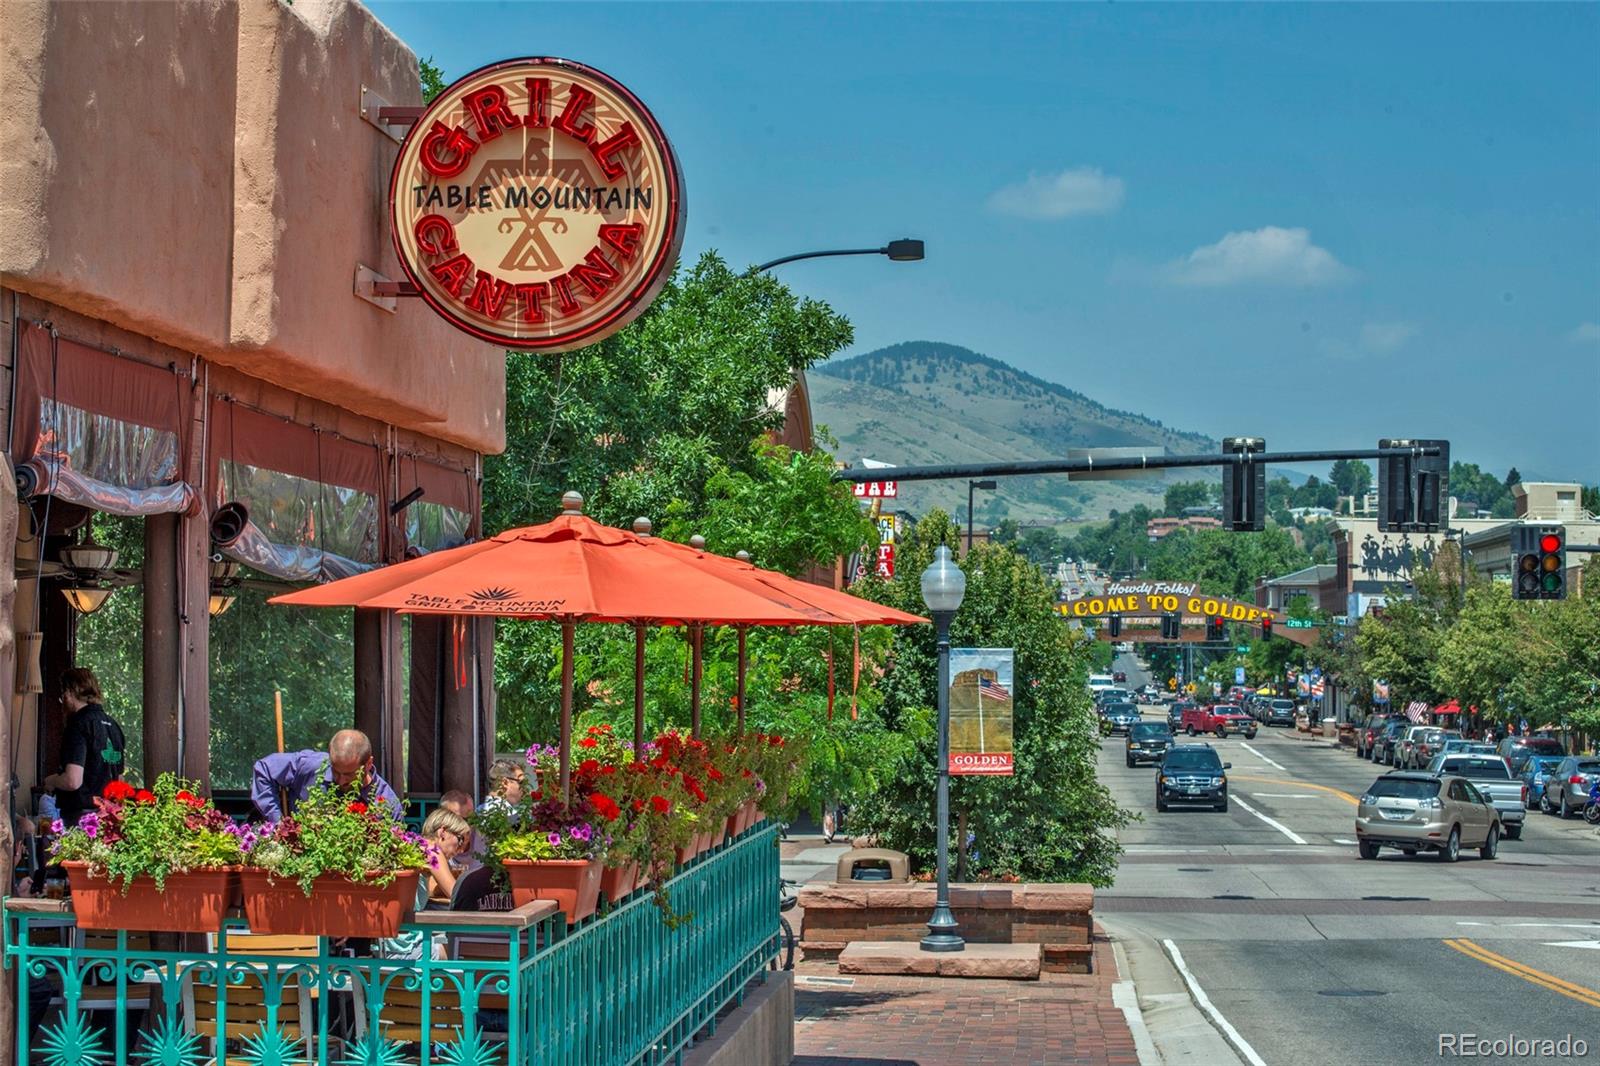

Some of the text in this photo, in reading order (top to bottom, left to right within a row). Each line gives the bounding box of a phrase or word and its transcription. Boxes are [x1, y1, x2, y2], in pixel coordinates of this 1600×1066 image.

[419, 77, 643, 182] GRILL
[413, 185, 652, 210] TABLE MOUNTAIN
[414, 213, 645, 325] CANTINA
[1107, 583, 1196, 596] Howdy Folks!
[405, 600, 453, 609] GRILL
[410, 593, 566, 607] TABLE MOUNTAIN
[1146, 594, 1178, 611] TO
[1287, 620, 1312, 628] 12th St
[954, 755, 1007, 765] GOLDEN
